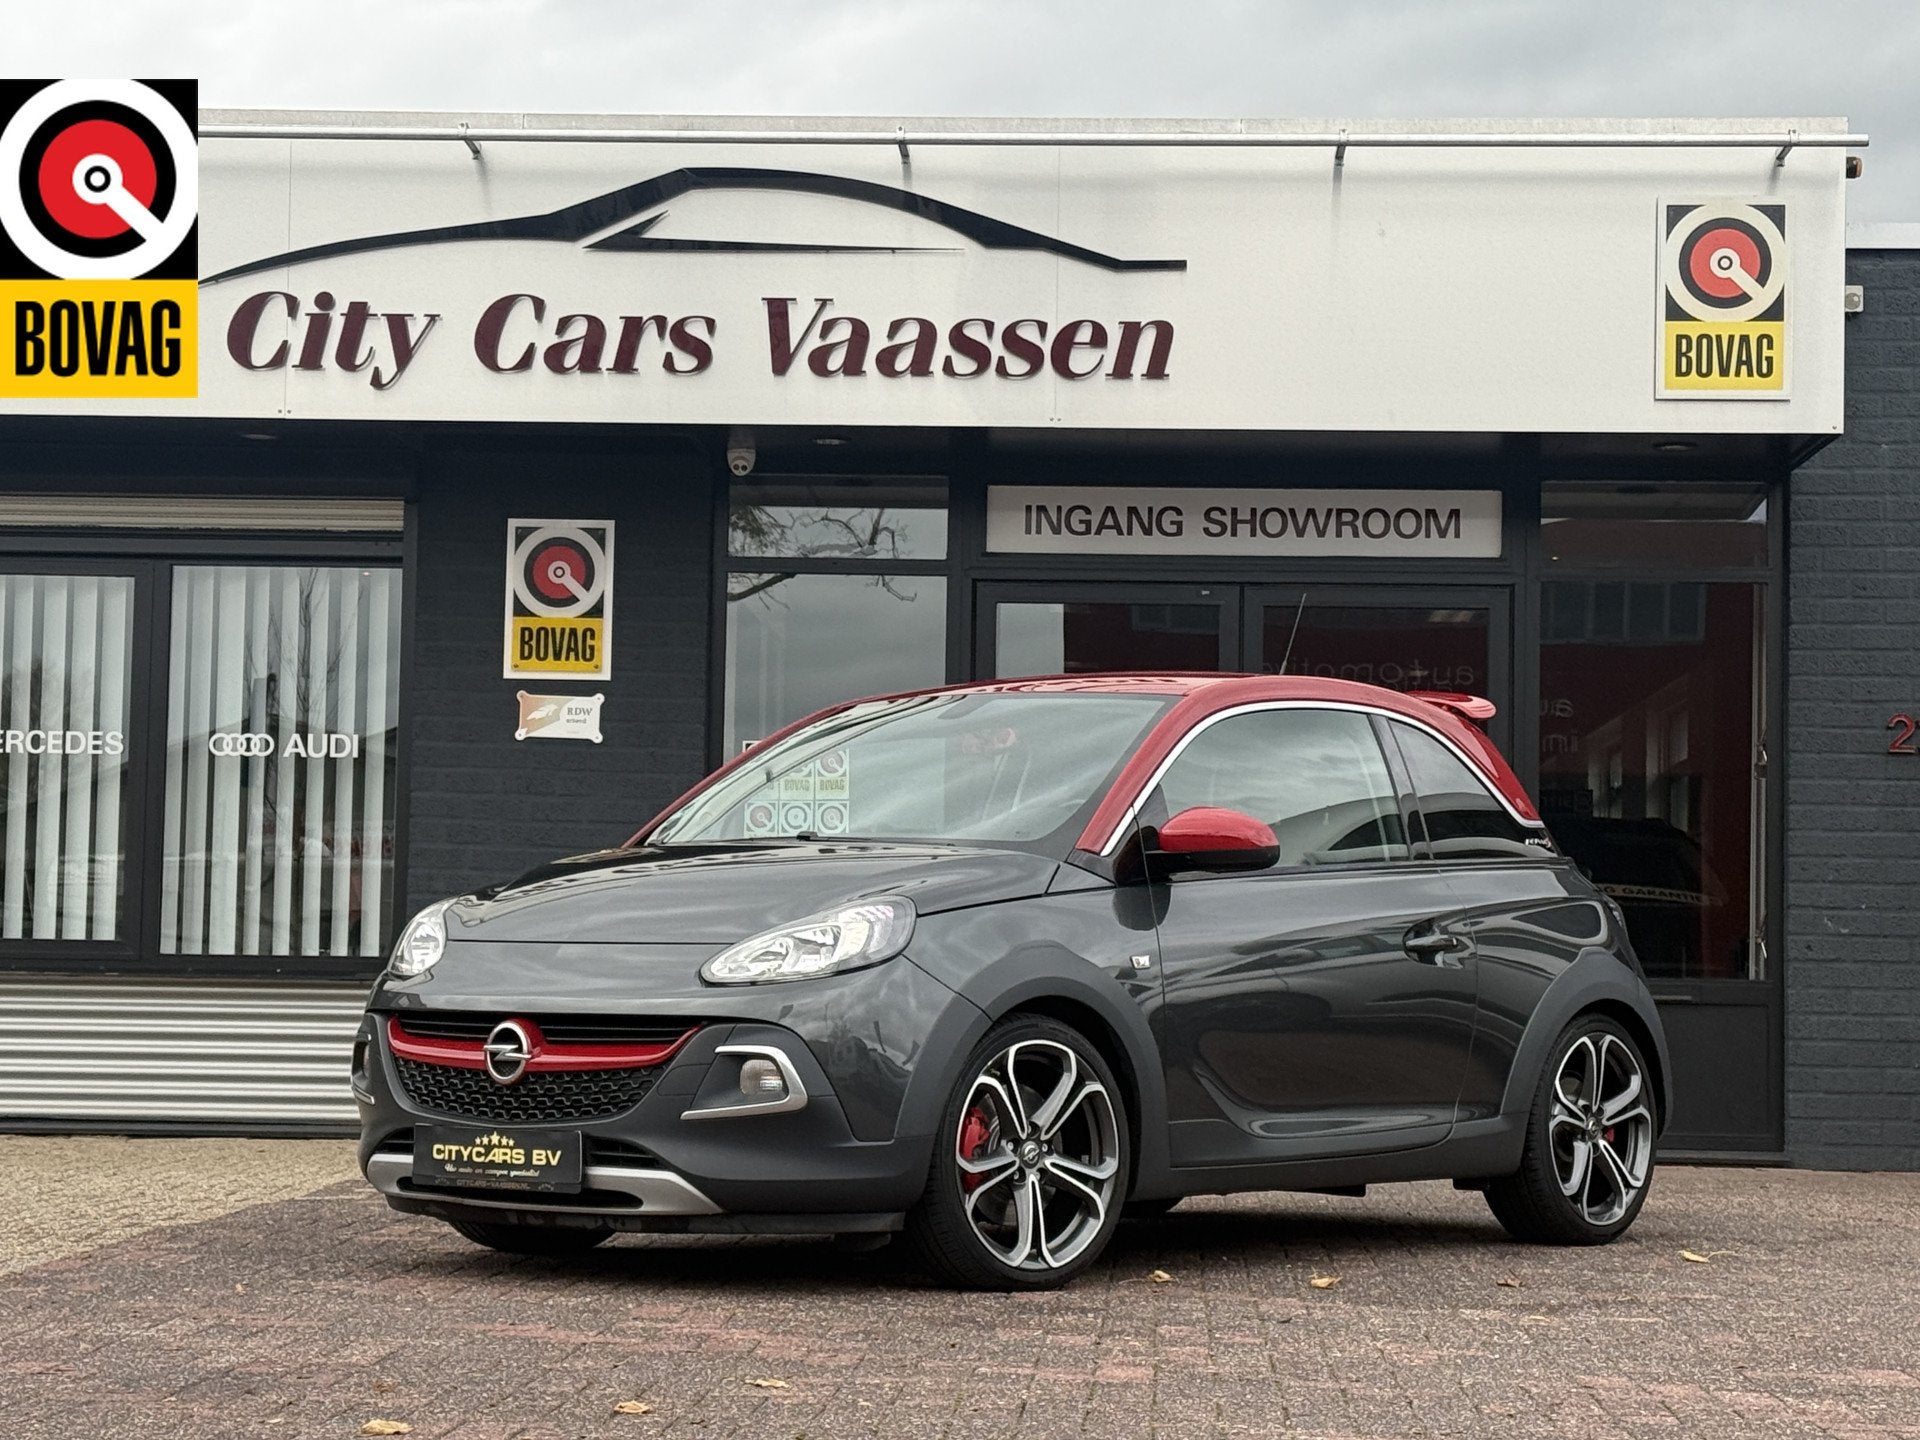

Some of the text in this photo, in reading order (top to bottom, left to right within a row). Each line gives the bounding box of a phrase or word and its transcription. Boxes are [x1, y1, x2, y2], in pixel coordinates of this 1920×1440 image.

[227, 291, 1174, 390] City Cars Vaassen
[1675, 334, 1774, 378] BOVAG
[1025, 504, 1462, 539] INGANG SHOWROOM
[520, 626, 596, 662] BOVAG
[567, 707, 593, 716] RDW
[0, 729, 124, 755] RCEDES
[282, 733, 359, 758] AUDI
[1888, 712, 1920, 752] 2
[819, 779, 845, 791] BOVAG
[432, 1143, 562, 1166] CITYCARS BV
